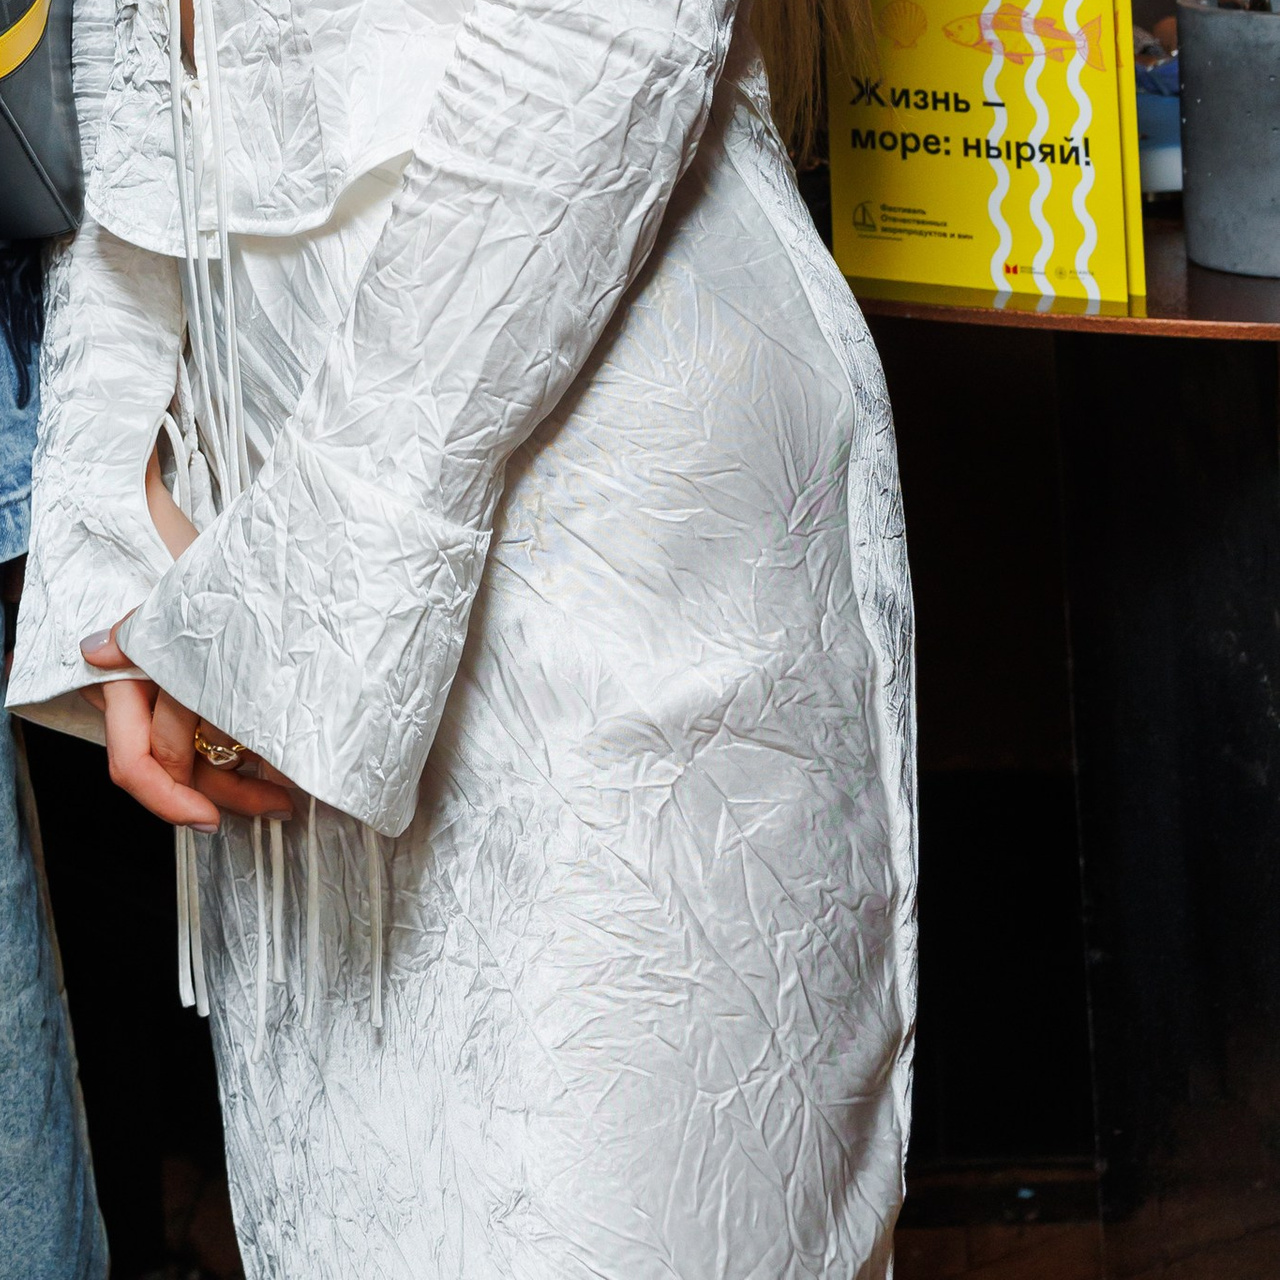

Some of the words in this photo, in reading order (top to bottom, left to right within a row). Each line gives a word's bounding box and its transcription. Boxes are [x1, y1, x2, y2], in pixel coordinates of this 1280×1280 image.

[849, 74, 971, 114] Жизнь
[851, 128, 951, 161] море:
[963, 135, 1091, 170] ныряй!
